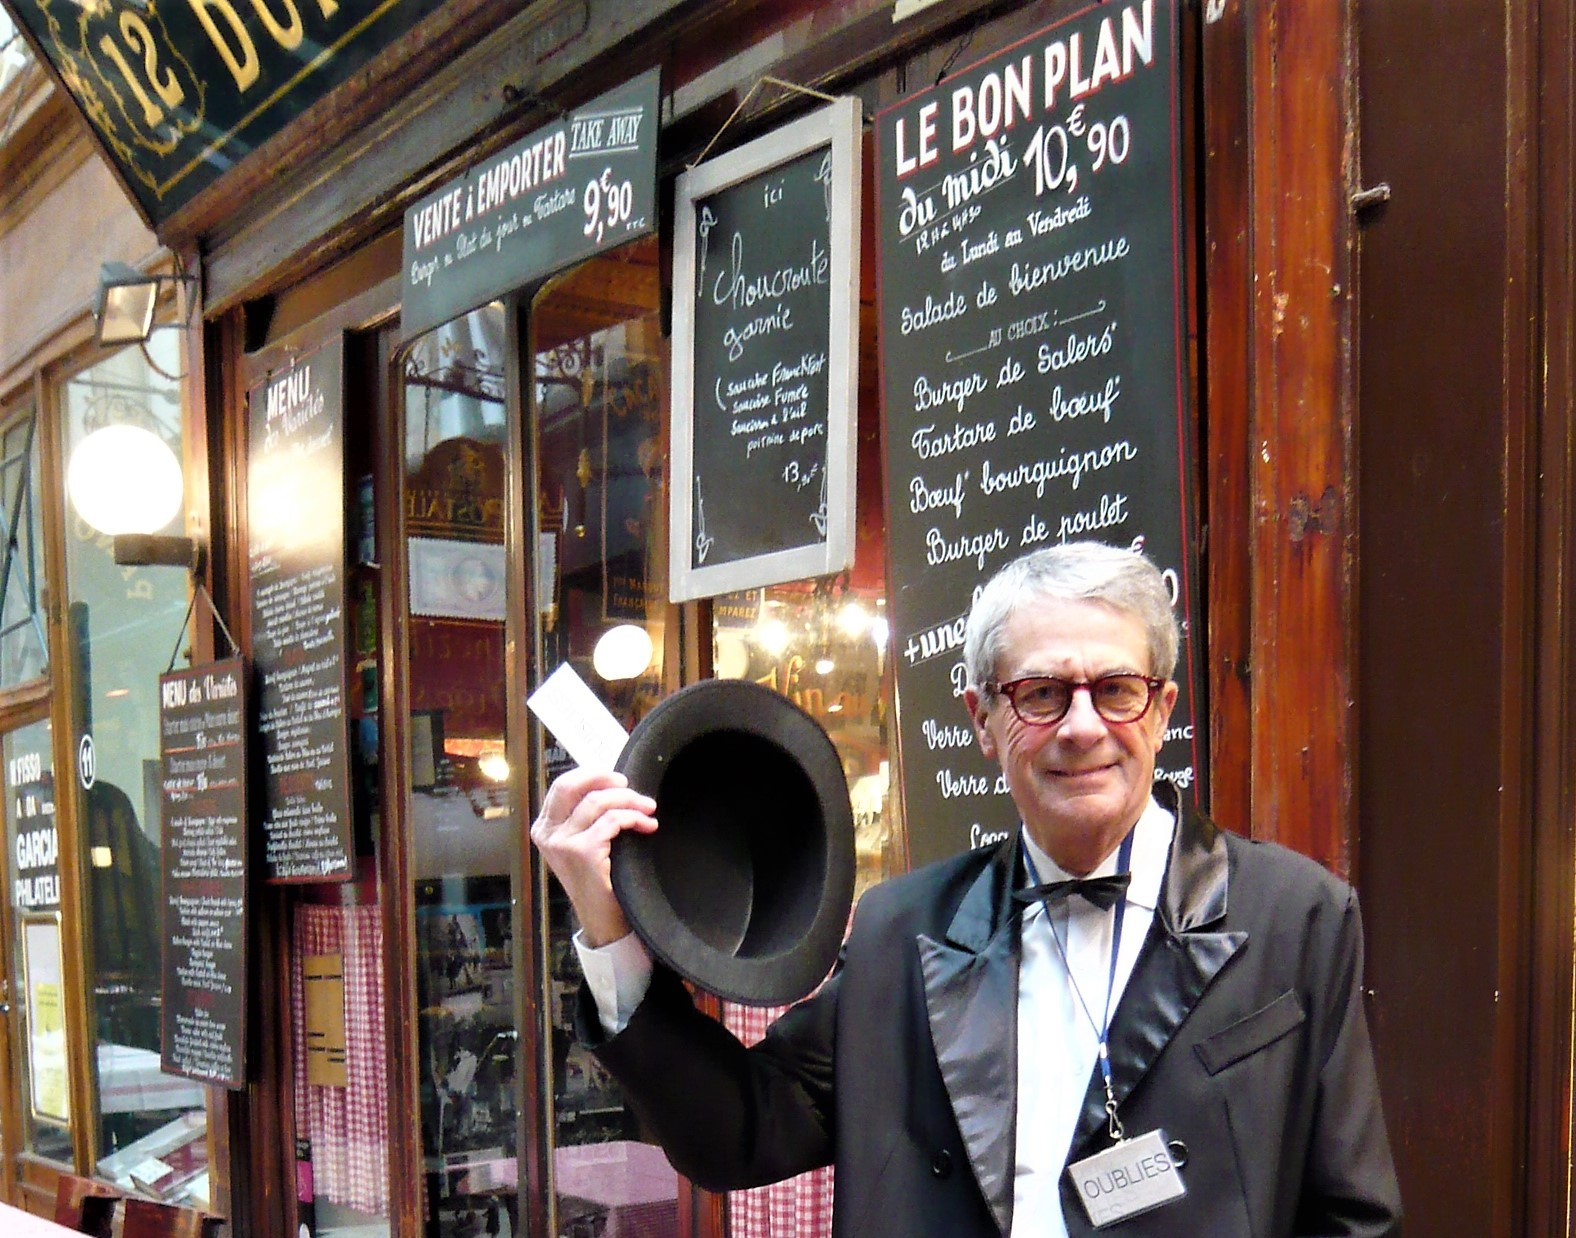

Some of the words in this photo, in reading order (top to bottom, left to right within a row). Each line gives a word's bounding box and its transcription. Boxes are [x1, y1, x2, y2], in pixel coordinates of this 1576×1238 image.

[99, 10, 185, 127] 12
[896, 101, 939, 179] LE
[951, 55, 1033, 152] BON
[1044, 0, 1154, 109] PLAN
[571, 119, 604, 152] TAKE
[606, 114, 643, 147] AWAY
[413, 187, 462, 249] VENTE
[477, 131, 567, 215] EMPORTER
[764, 179, 785, 209] ici
[899, 187, 937, 235] du
[942, 135, 1018, 209] midi
[961, 231, 999, 264] Lundi
[1027, 197, 1092, 237] Vendredi
[714, 232, 829, 309] Choucroute
[901, 296, 968, 334] Salade
[977, 282, 998, 309] de
[1008, 236, 1131, 297] bienvenue
[723, 303, 794, 361] garnie
[988, 331, 1002, 349] AU
[267, 365, 310, 421] MENU
[914, 374, 989, 412] Burger
[997, 357, 1026, 390] de
[911, 420, 998, 460] Tartare
[1007, 405, 1036, 438] de
[980, 440, 1137, 499] bourguignon
[926, 527, 1010, 572] Burger
[1020, 514, 1050, 547] de
[1057, 492, 1129, 544] poulet
[163, 680, 187, 709] MENU
[82, 746, 93, 778] 11
[922, 719, 973, 750] Verre
[936, 769, 989, 799] Verre
[16, 828, 59, 870] GARCIA
[15, 875, 61, 907] PHILATELI
[1084, 1152, 1171, 1199] OUBLIES
